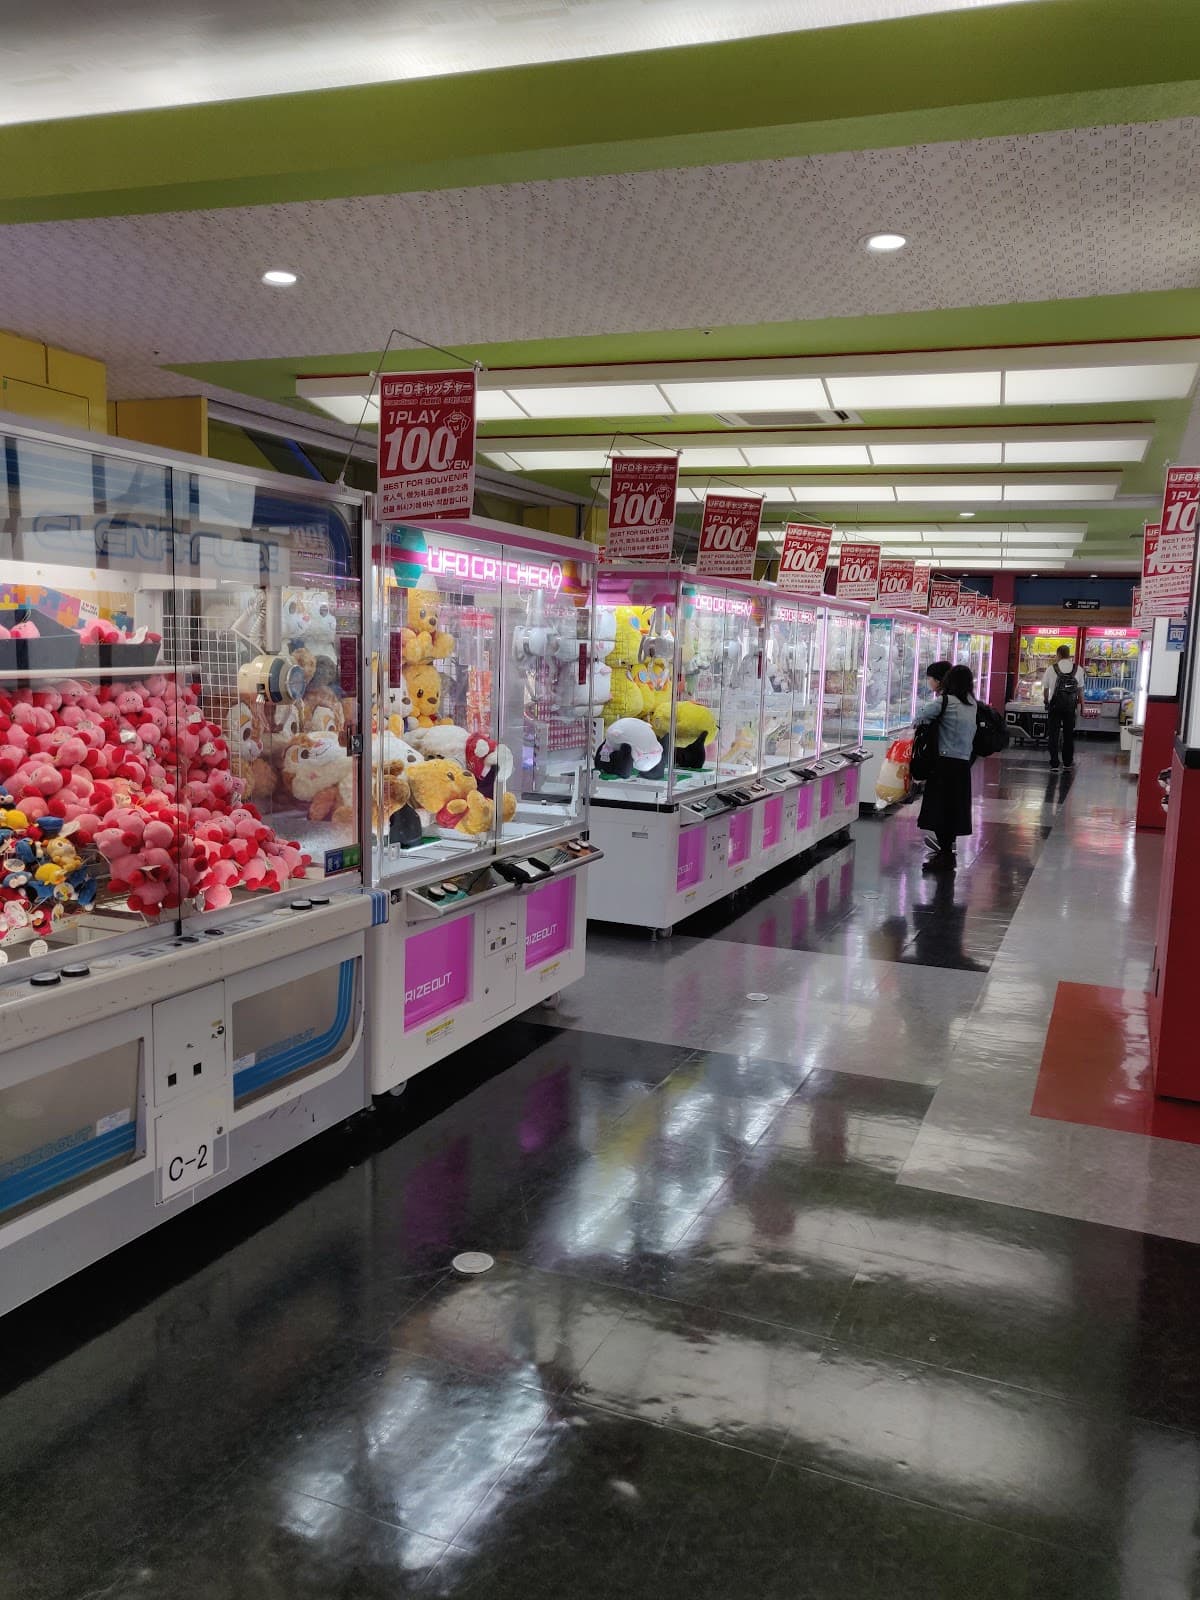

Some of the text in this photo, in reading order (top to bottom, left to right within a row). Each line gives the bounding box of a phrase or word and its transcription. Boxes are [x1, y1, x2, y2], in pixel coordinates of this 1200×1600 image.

[384, 380, 473, 397] UFOキャッチャー
[385, 426, 458, 471] 100
[447, 459, 470, 471] YEN
[383, 473, 468, 491] BEST FOR SOUVENIR
[612, 493, 664, 525] 100
[703, 524, 748, 551] 100
[783, 548, 819, 571] 100
[841, 564, 872, 582] 100
[169, 1144, 208, 1181] C-2
